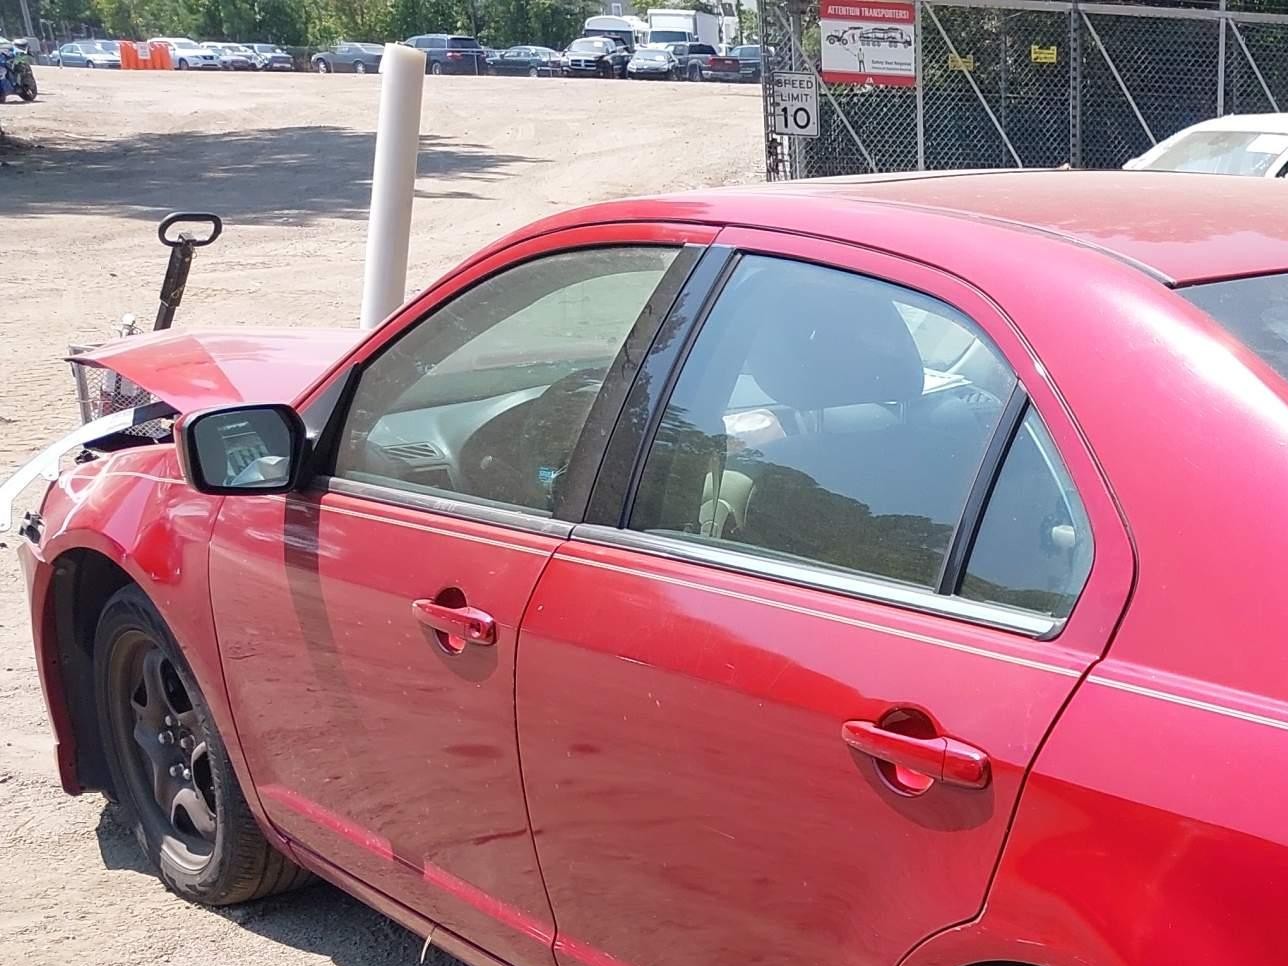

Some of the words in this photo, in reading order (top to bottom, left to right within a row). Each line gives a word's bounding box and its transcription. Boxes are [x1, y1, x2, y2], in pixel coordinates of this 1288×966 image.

[827, 5, 860, 16] ATTENTION
[776, 78, 814, 89] SPEED
[780, 92, 810, 102] LIMIT
[781, 106, 811, 129] 10
